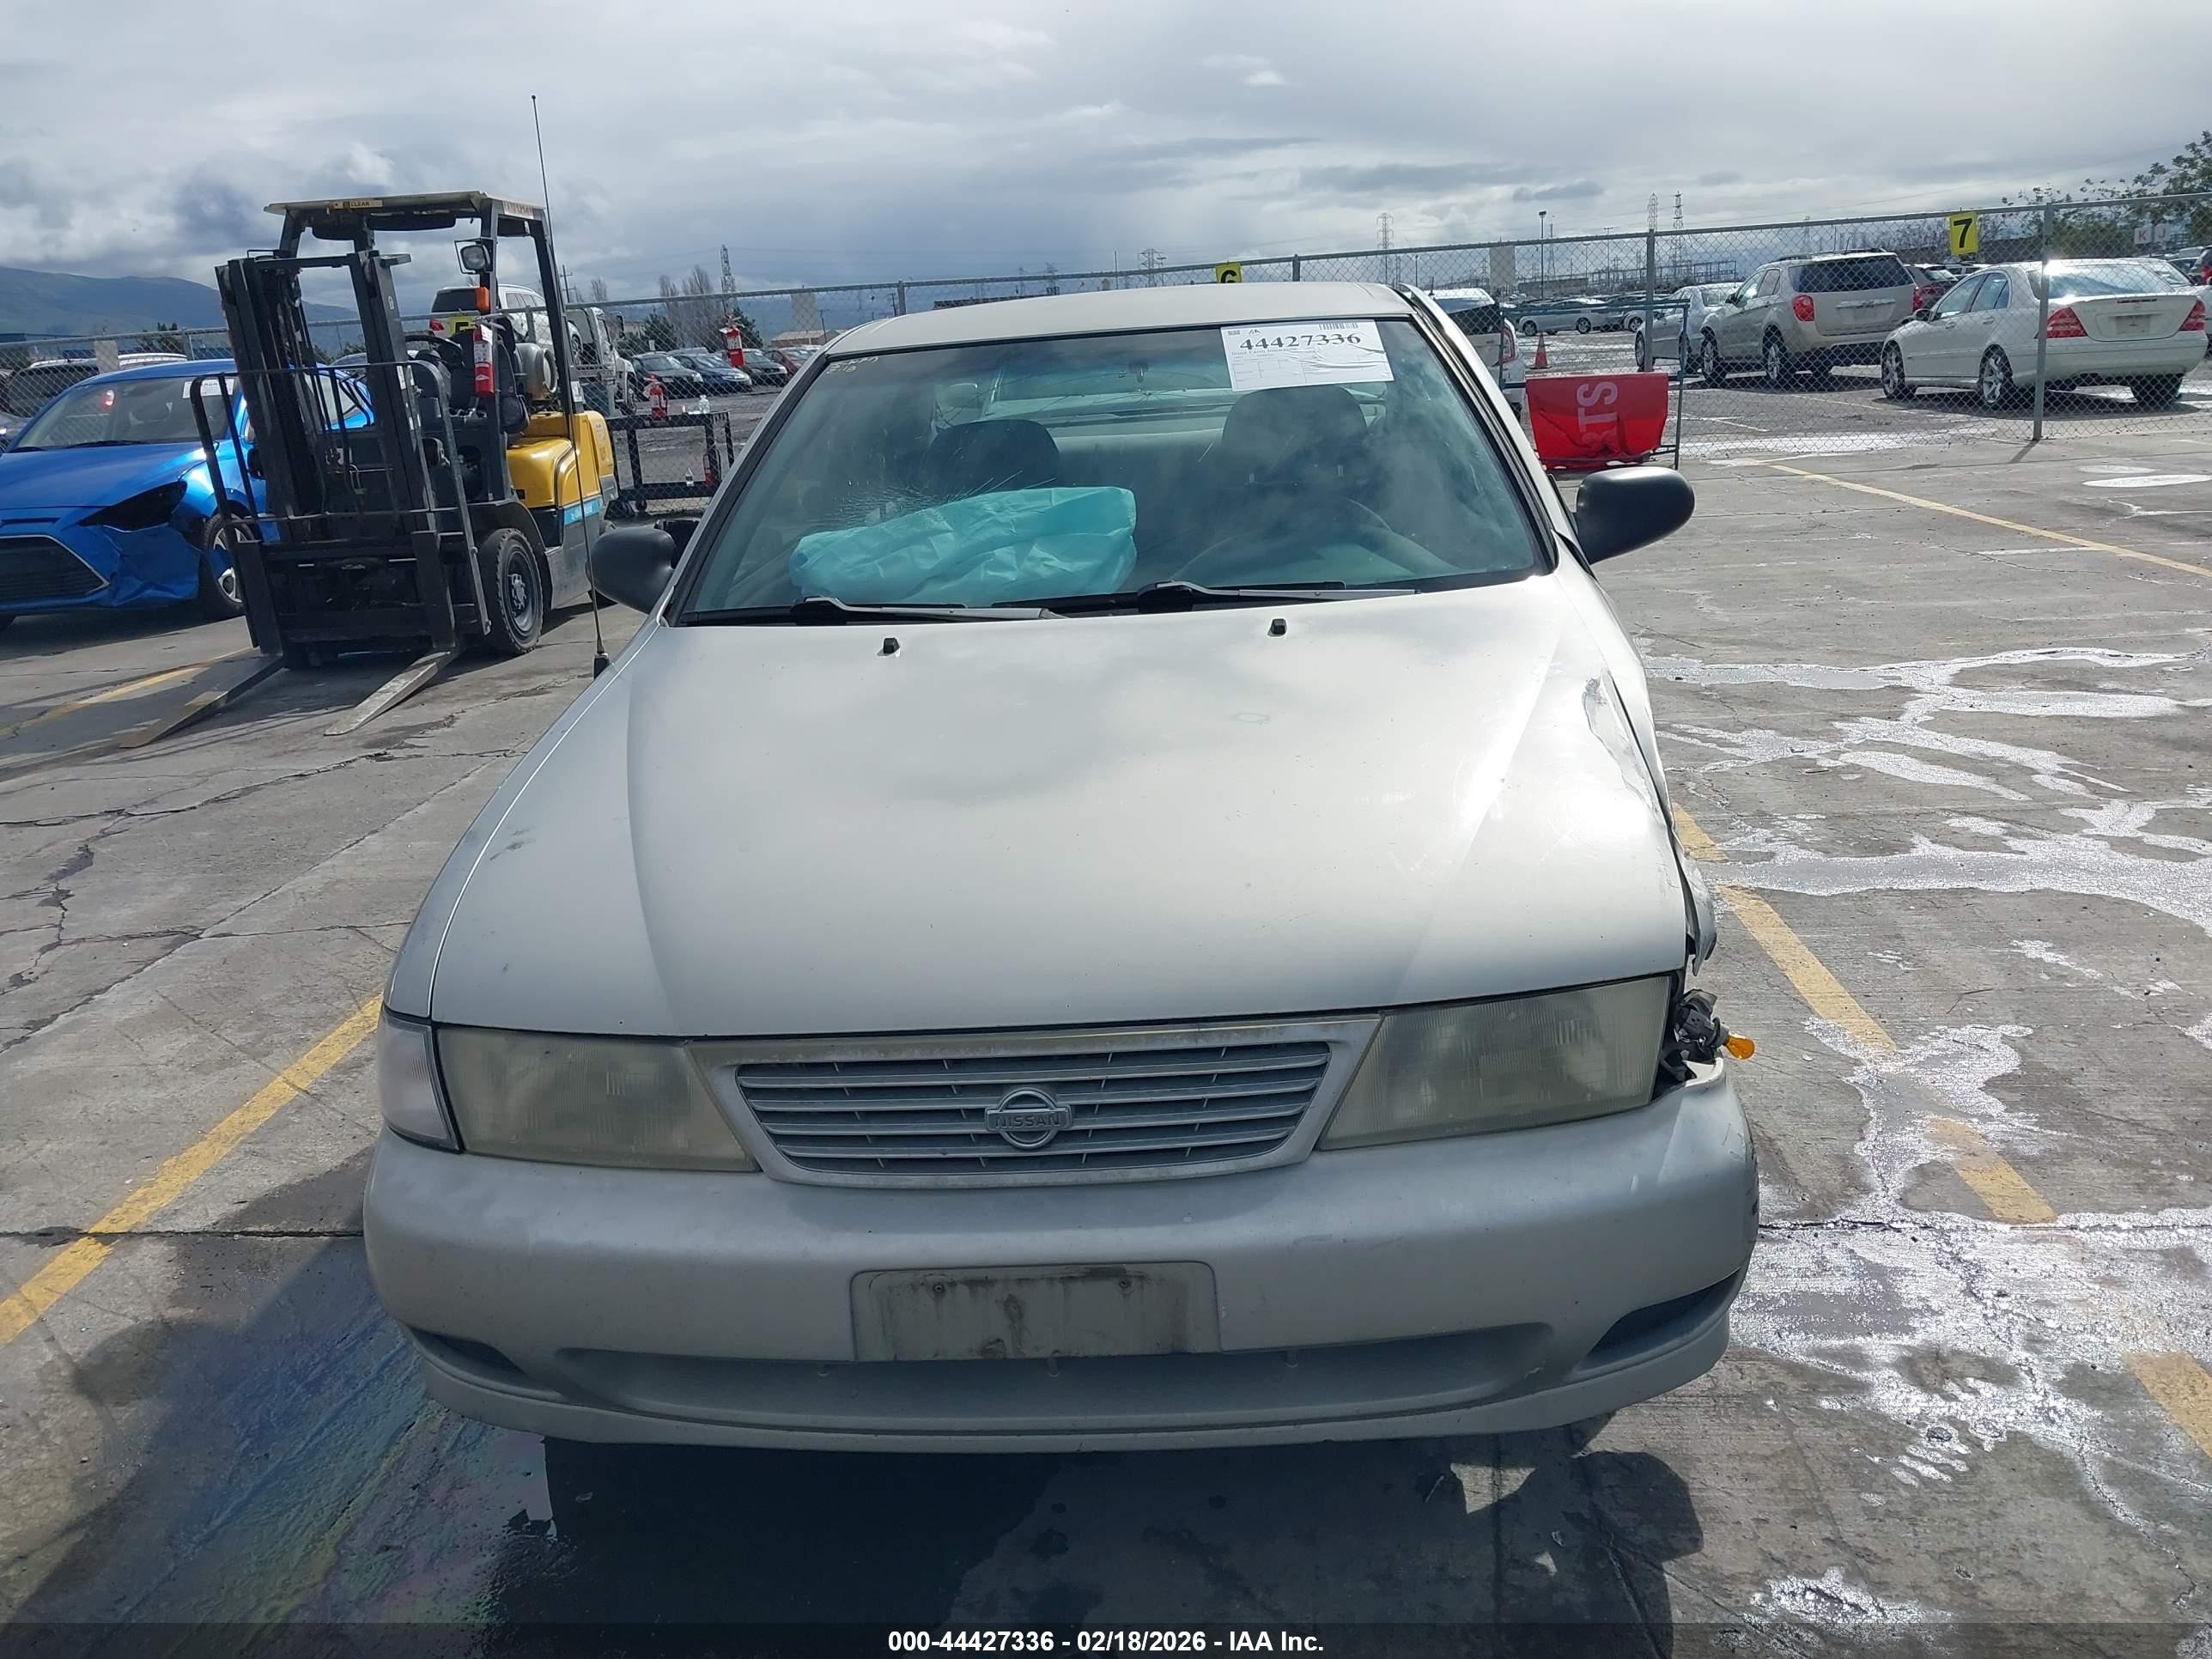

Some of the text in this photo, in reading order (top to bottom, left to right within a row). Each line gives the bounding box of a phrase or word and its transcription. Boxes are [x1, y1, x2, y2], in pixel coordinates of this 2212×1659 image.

[1954, 218, 1972, 248] 7
[1239, 332, 1362, 350] 44427336
[996, 1113, 1061, 1129] NISSAN
